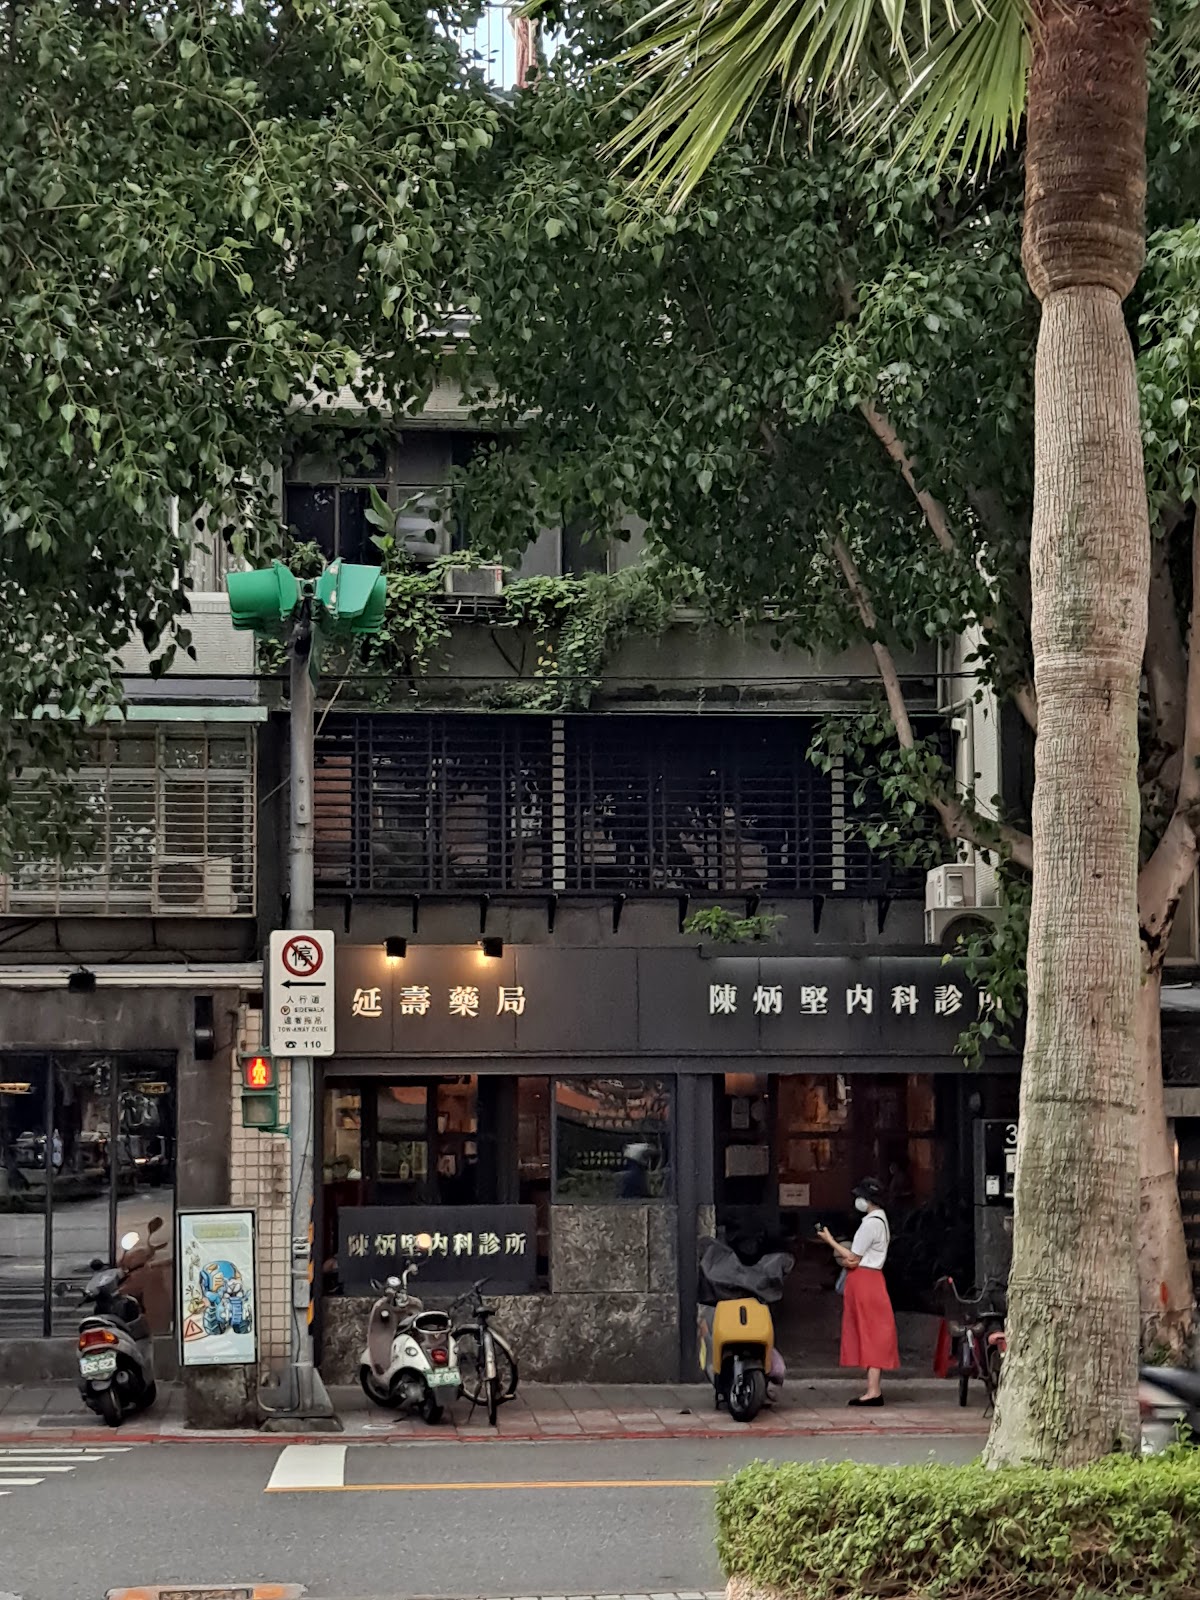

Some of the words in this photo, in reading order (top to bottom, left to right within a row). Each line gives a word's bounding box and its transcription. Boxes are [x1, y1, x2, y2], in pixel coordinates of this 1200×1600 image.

[286, 995, 320, 1005] 人行道
[352, 985, 526, 1018] 延壽藥局
[304, 1040, 322, 1049] 110
